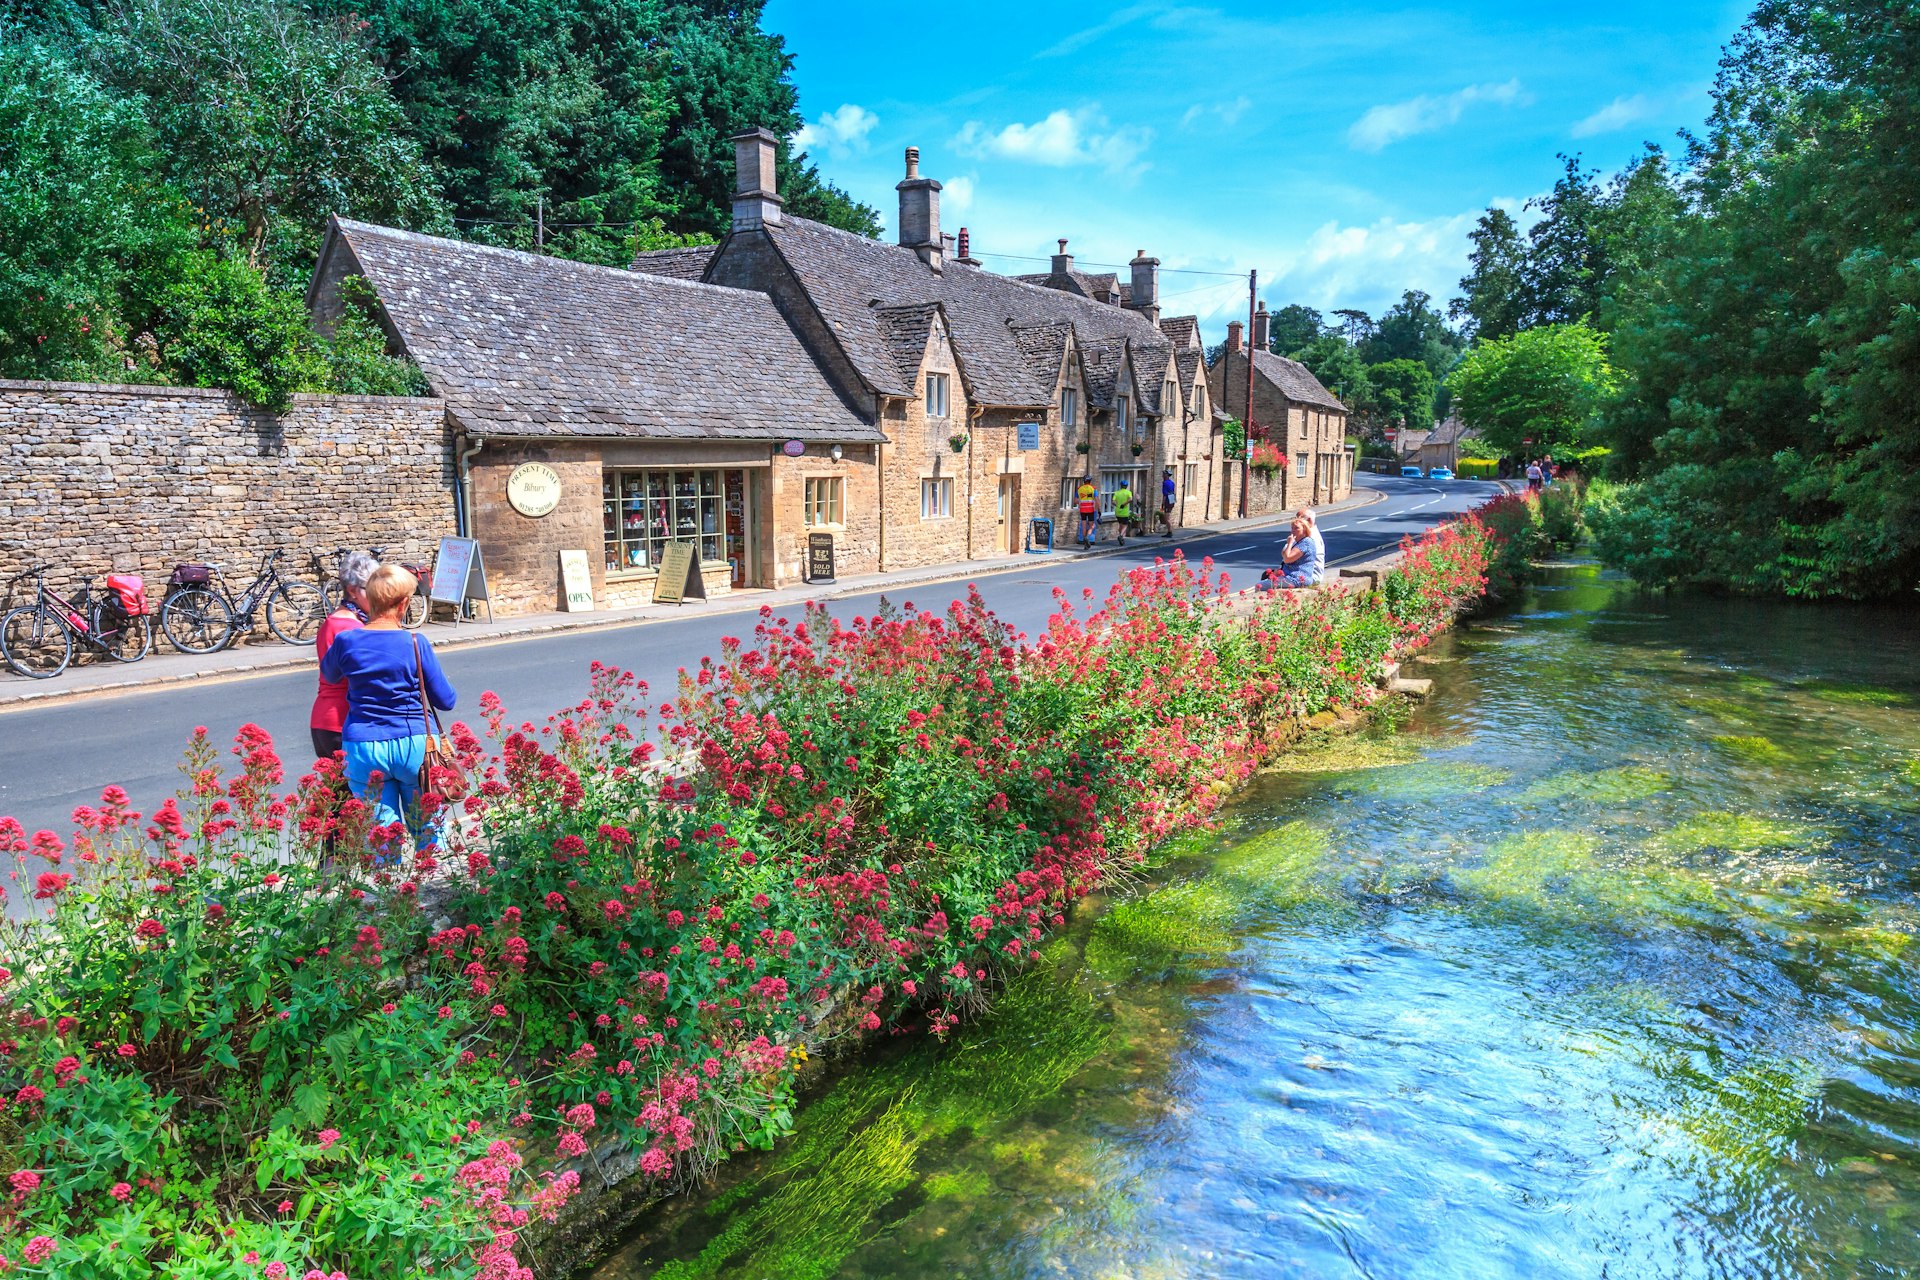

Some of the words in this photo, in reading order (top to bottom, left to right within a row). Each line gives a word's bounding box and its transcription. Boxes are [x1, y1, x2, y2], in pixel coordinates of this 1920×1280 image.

[511, 466, 539, 484] PRESENT
[542, 469, 558, 485] TIME
[524, 483, 546, 494] Bibury
[568, 592, 592, 603] OPEN
[661, 589, 678, 597] OPEN
